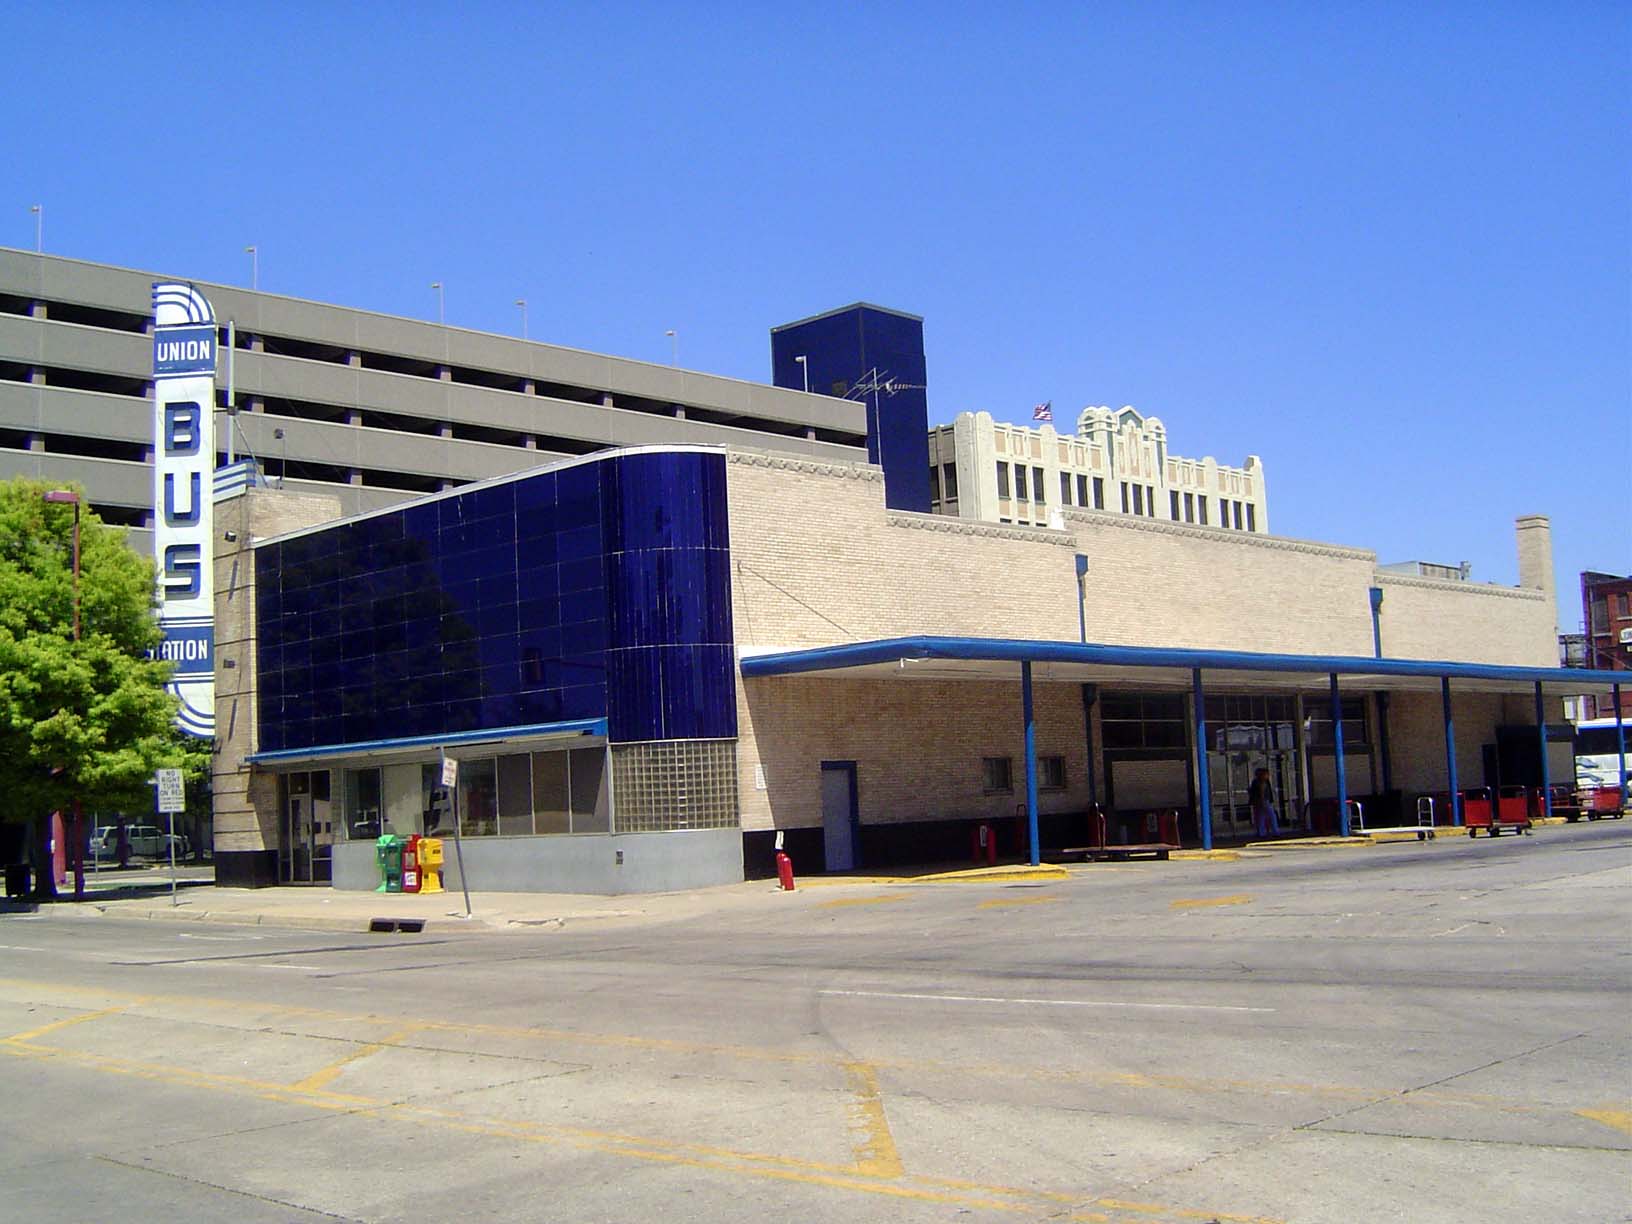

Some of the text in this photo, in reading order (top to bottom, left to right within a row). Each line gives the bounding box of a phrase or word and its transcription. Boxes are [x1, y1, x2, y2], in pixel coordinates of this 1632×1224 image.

[157, 340, 210, 361] UNION
[164, 401, 201, 602] BUS
[145, 639, 208, 661] ATION
